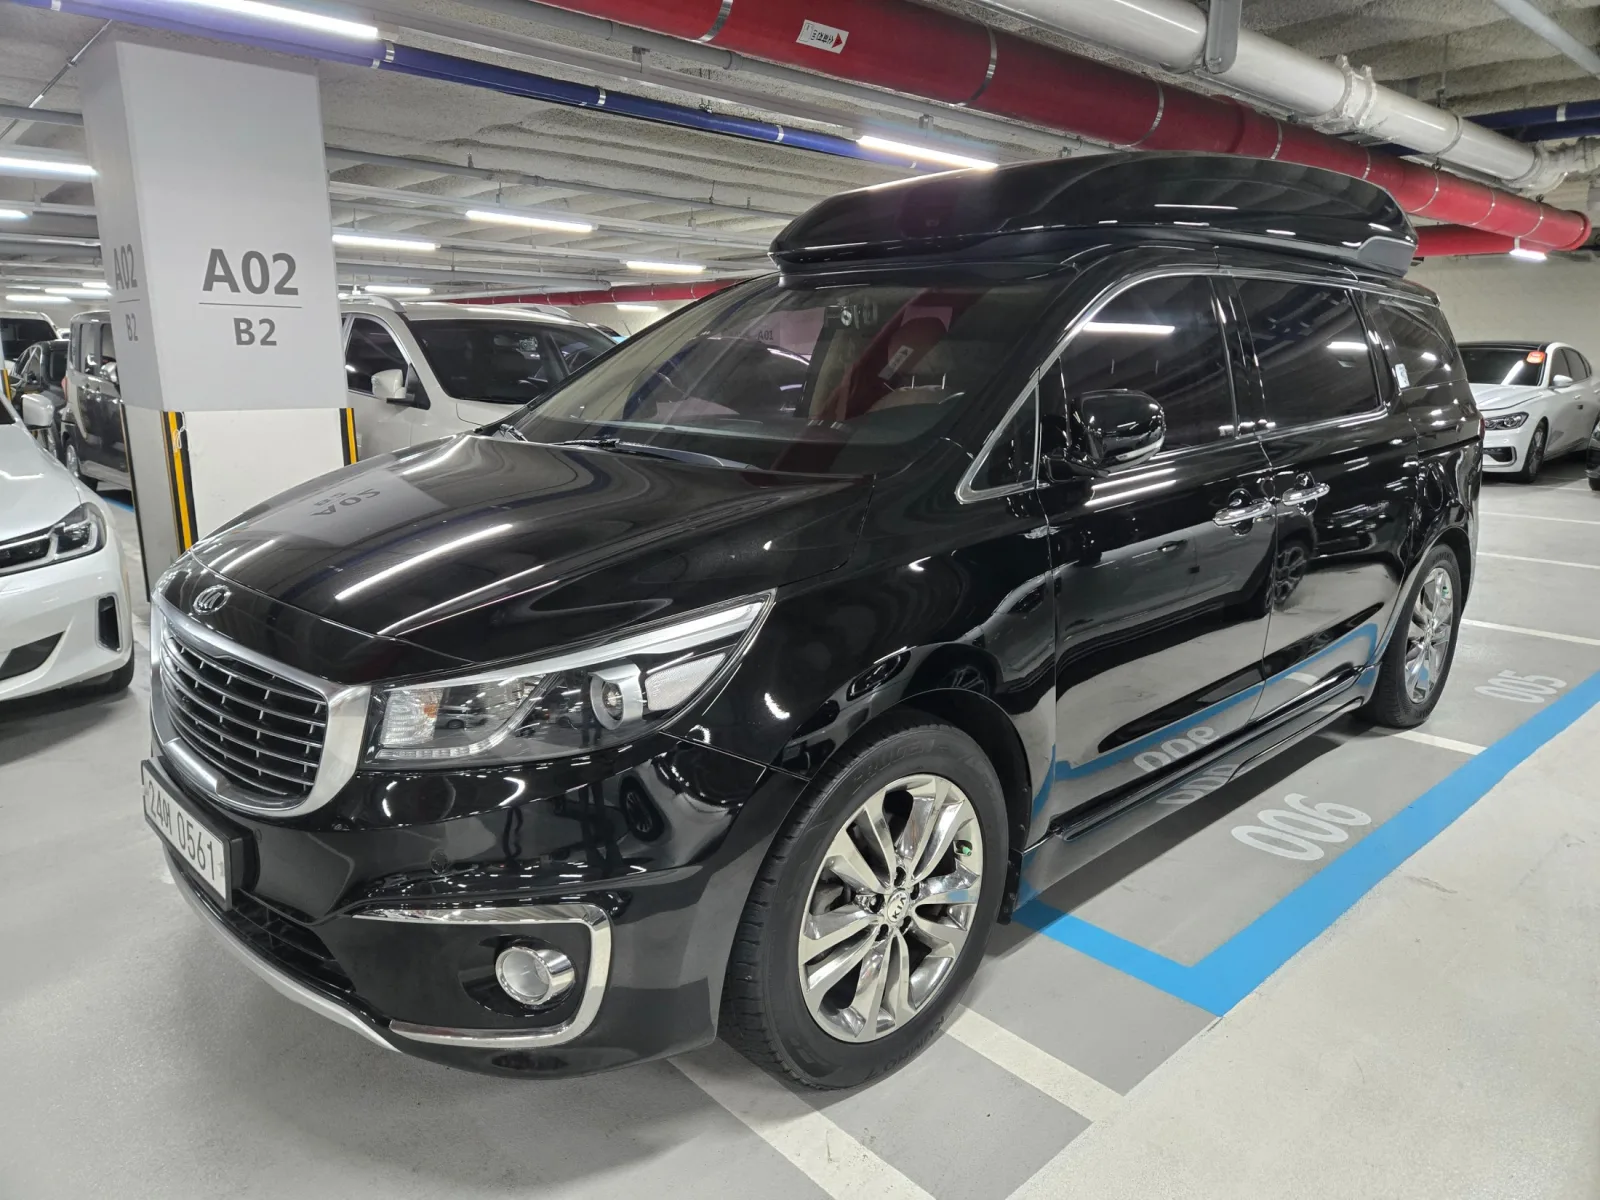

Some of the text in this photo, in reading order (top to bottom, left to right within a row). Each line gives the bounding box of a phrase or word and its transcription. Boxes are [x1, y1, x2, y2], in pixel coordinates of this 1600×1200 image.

[113, 243, 138, 291] A02
[202, 248, 299, 296] A02
[125, 313, 139, 342] B2
[233, 317, 277, 346] B2
[1474, 669, 1567, 703] 005
[177, 811, 215, 881] 0561
[1231, 792, 1372, 861] 006
[892, 896, 907, 920] KIA
